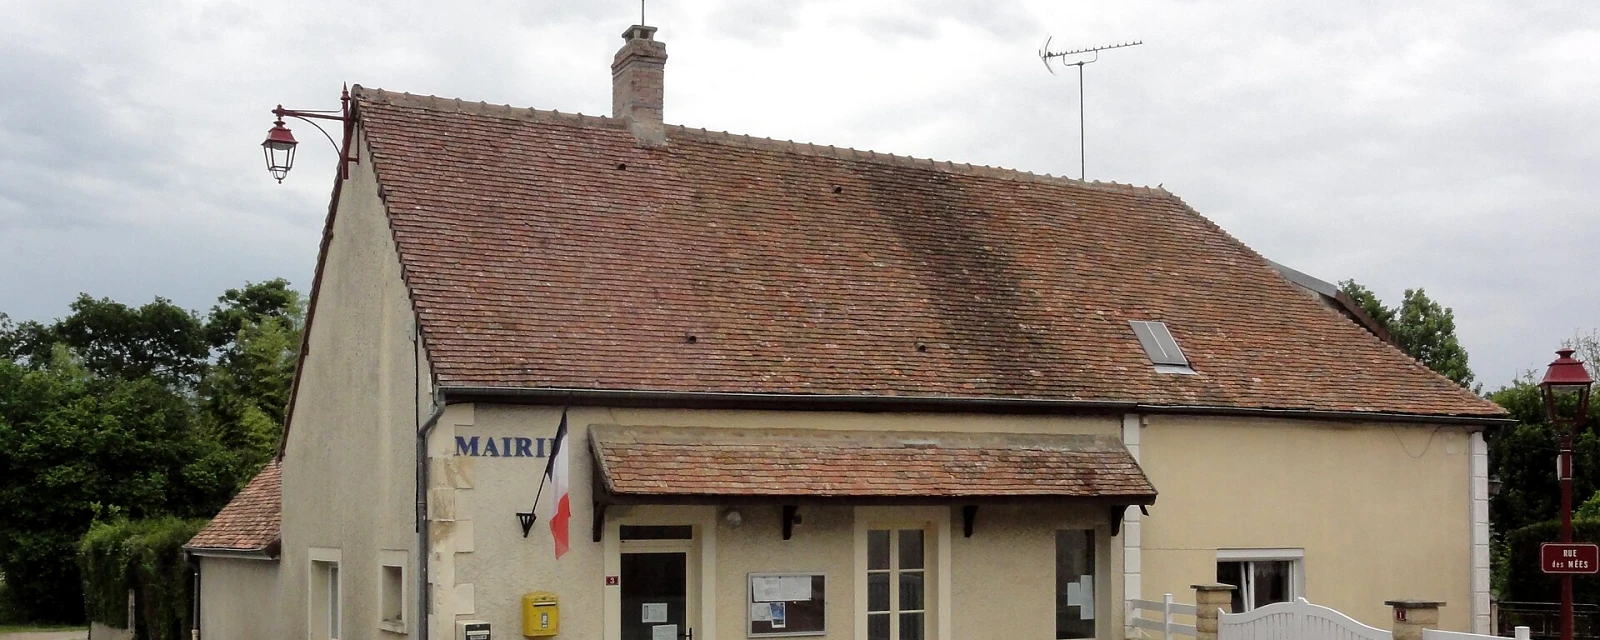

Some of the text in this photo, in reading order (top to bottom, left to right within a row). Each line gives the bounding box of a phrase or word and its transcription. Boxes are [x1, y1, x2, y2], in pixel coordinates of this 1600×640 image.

[1563, 549, 1577, 557] RUE
[1551, 559, 1589, 569] des MÉES
